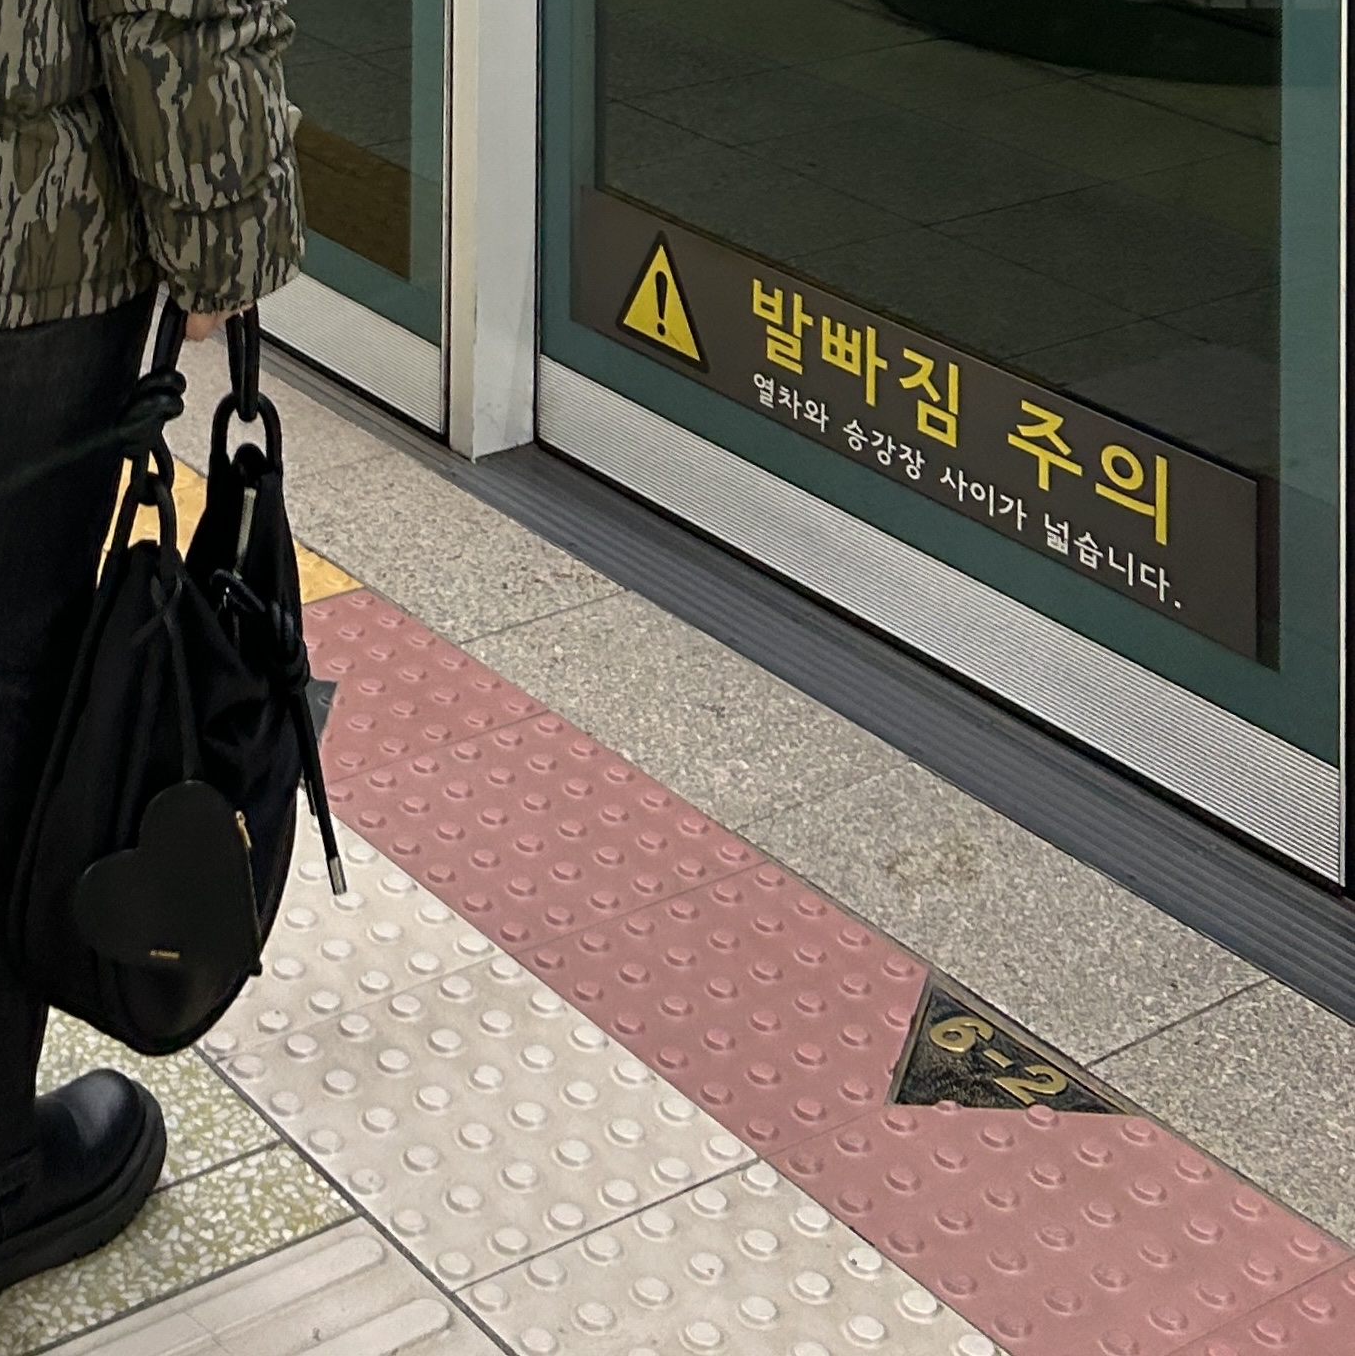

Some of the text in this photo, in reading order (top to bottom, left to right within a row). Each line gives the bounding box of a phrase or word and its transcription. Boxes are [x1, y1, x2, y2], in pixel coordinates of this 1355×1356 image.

[753, 278, 1168, 546] 발빠짐 주의
[753, 373, 1182, 609] 열차와 승강장 사이가 넓습니다.
[929, 1015, 1068, 1107] 6-2
